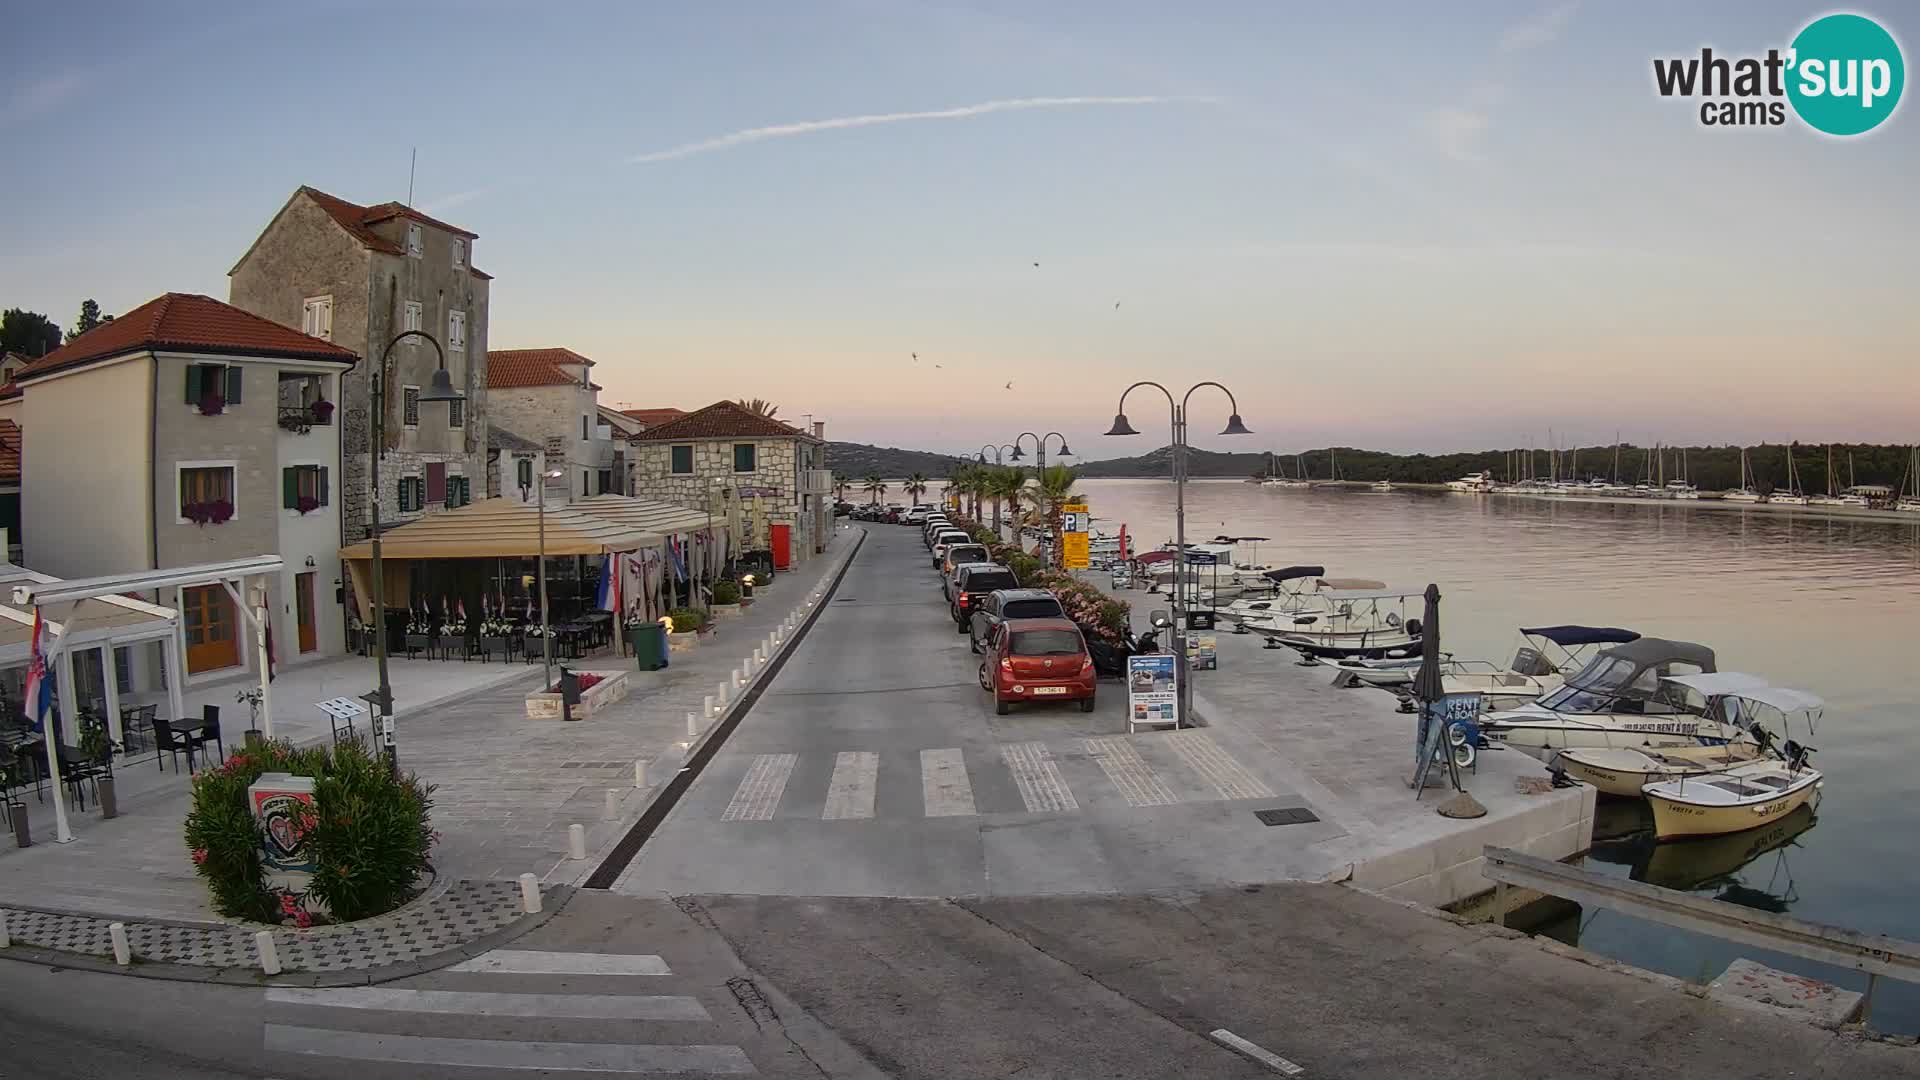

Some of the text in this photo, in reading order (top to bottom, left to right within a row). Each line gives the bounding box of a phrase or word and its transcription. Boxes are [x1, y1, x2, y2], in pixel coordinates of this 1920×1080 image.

[1446, 698, 1479, 711] RENT
[1446, 710, 1477, 720] A BOAT
[1657, 723, 1675, 733] RENT
[1675, 723, 1681, 733] A
